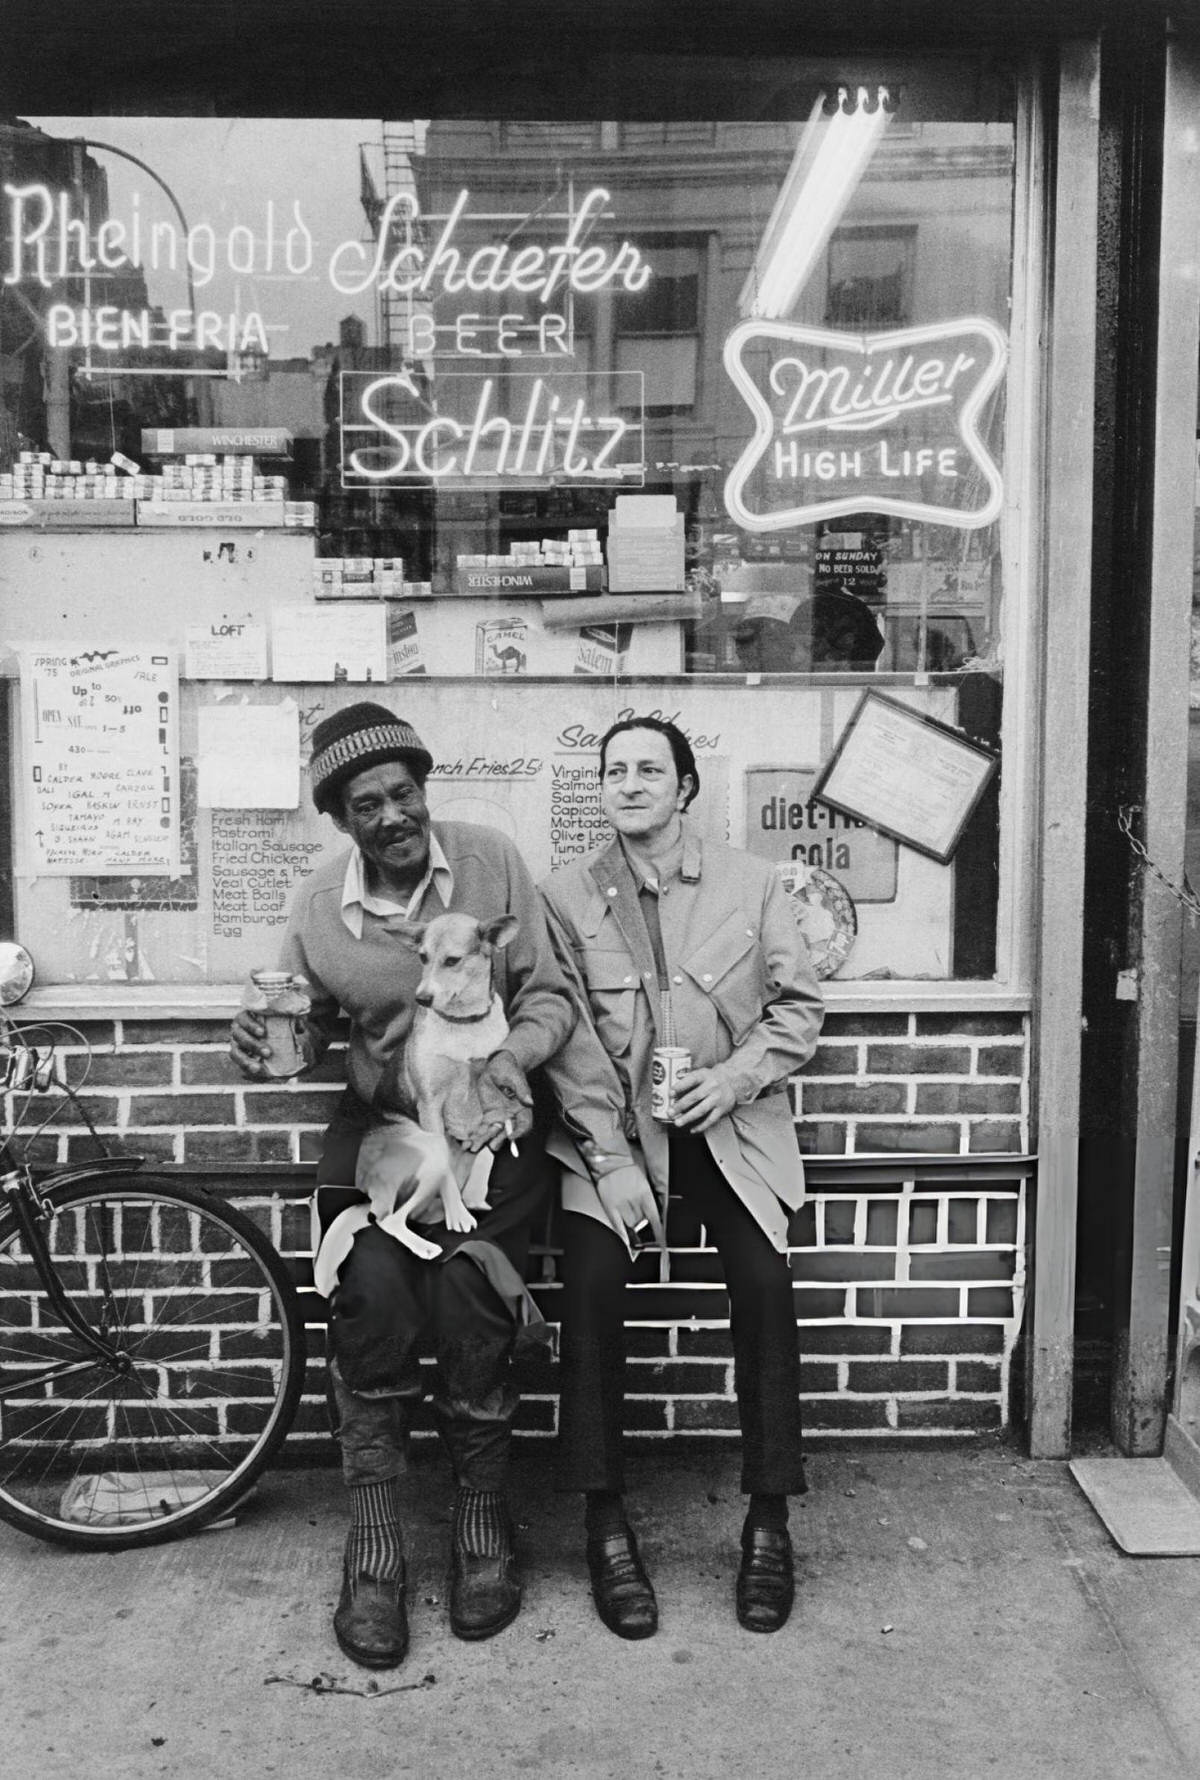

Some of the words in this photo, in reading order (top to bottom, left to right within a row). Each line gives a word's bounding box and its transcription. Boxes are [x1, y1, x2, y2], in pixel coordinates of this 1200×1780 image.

[4, 184, 312, 287] Rheingold
[329, 188, 651, 302] Schaefer
[48, 304, 149, 349] BIEN
[170, 308, 268, 353] FRIA
[409, 313, 568, 354] BEER
[769, 353, 976, 428] Miller
[350, 376, 626, 479] Schlitz
[211, 434, 278, 448] WINCHESTER
[815, 551, 831, 561] ON
[835, 551, 878, 561] SUNDAY
[833, 563, 853, 574] BEER
[467, 575, 533, 587] WINCHESTER
[211, 624, 246, 636] LOFT
[487, 631, 525, 643] CAMEL
[72, 685, 88, 697] Up
[91, 682, 102, 691] to
[466, 757, 509, 775] Fries
[212, 813, 250, 826] Fresh
[212, 826, 274, 838] Pastrami
[551, 829, 586, 842] Olive
[212, 839, 258, 851] Italian
[261, 839, 324, 854] Sausage
[552, 841, 585, 854] Tuna
[791, 837, 850, 870] cola
[212, 852, 248, 864] Fried
[250, 851, 309, 864] Chicken
[212, 865, 275, 879] Sausage
[212, 877, 243, 889] Veal
[247, 877, 293, 889] Cutlet
[213, 888, 248, 900] Meat
[252, 888, 287, 900] Balls
[213, 901, 248, 912] Meat
[253, 900, 286, 912] Loaf
[213, 912, 289, 926] Hamburger
[213, 923, 242, 938] Egg
